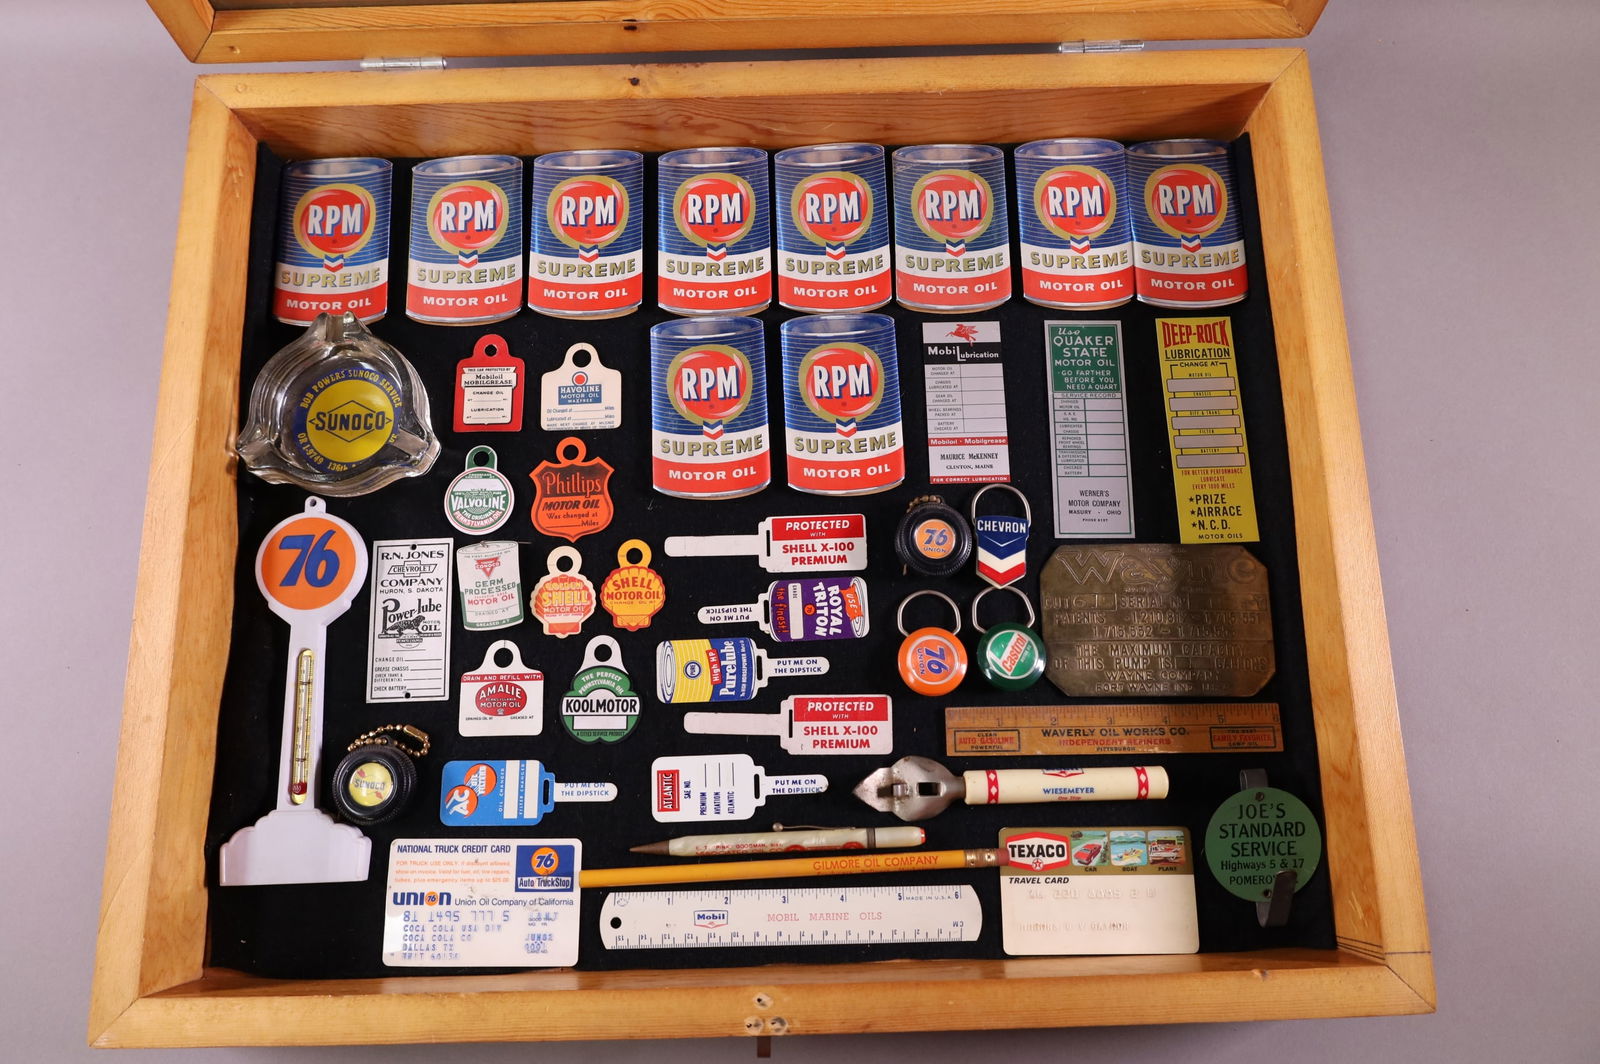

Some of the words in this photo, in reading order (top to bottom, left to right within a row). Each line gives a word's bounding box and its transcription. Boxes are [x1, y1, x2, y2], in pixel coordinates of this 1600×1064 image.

[925, 189, 980, 221] RPM
[1048, 185, 1104, 217] RPM
[1158, 184, 1214, 216] RPM
[561, 195, 615, 227] RPM
[687, 192, 742, 225] RPM
[805, 191, 860, 224] RPM
[307, 203, 363, 236] RPM
[440, 199, 496, 233] RPM
[785, 254, 884, 277] SUPREME
[905, 252, 1004, 273] SUPREME
[1031, 250, 1128, 270] SUPREME
[1142, 249, 1240, 269] SUPREME
[538, 259, 636, 278] SUPREME
[666, 256, 764, 277] SUPREME
[281, 268, 381, 288] SUPREME
[417, 263, 515, 285] SUPREME
[913, 282, 969, 295] MOTOR
[974, 281, 998, 292] OIL
[1040, 280, 1095, 292] MOTOR
[1100, 279, 1124, 289] OIL
[1151, 278, 1206, 290] MOTOR
[1211, 279, 1235, 288] OIL
[543, 288, 599, 300] MOTOR
[605, 288, 629, 299] OIL
[673, 287, 729, 300] MOTOR
[734, 286, 758, 297] OIL
[793, 286, 849, 299] MOTOR
[853, 285, 878, 296] OIL
[287, 298, 342, 311] MOTOR
[348, 297, 372, 310] OIL
[423, 295, 479, 307] MOTOR
[485, 293, 508, 305] OIL
[1053, 336, 1114, 346] QUAKER
[1161, 319, 1230, 349] DEEP-ROCK
[1063, 347, 1107, 357] STATE
[1164, 347, 1231, 359] LUBRICATION
[1054, 359, 1091, 367] MOTOR
[1097, 359, 1115, 367] OIL
[681, 366, 740, 400] RPM
[813, 363, 871, 398] RPM
[300, 391, 314, 409] BOB
[312, 370, 346, 393] POWERS
[348, 369, 379, 382] SUNOCO
[379, 379, 403, 408] SERVICE
[560, 385, 600, 393] HAVOLINE
[315, 411, 386, 431] SUNOCO
[660, 434, 763, 457] SUPREME
[794, 432, 897, 455] SUPREME
[669, 470, 727, 481] MOTOR
[732, 466, 757, 477] OIL
[803, 467, 861, 478] MOTOR
[866, 464, 891, 476] OIL
[542, 472, 601, 497] Phillips
[451, 494, 506, 511] VALVOLINE
[542, 501, 580, 512] MOTOR
[583, 499, 600, 509] OIL
[1195, 493, 1227, 505] PRIZE
[562, 512, 589, 520] changed
[1196, 505, 1242, 518] AIRRACE
[785, 520, 850, 531] PROTECTED
[977, 520, 1027, 534] CHEVRON
[924, 528, 948, 546] 76
[782, 543, 817, 554] SHELL
[820, 541, 854, 552] X-100
[278, 529, 340, 588] 76
[791, 555, 848, 566] PREMIUM
[393, 565, 432, 573] CHEVROLET
[380, 578, 444, 588] COMPANY
[465, 582, 516, 595] PROCESSED
[475, 578, 504, 588] GERM
[612, 576, 652, 591] SHELL
[501, 594, 514, 602] OIL
[541, 590, 589, 606] SHELL
[606, 591, 643, 600] MOTOR
[645, 591, 661, 600] OIL
[812, 581, 827, 637] TRITON
[827, 584, 843, 636] ROYAL
[1001, 633, 1028, 673] Castrol
[1075, 644, 1099, 656] THE
[1109, 644, 1172, 656] MAXIMUM
[720, 640, 735, 696] Purelube
[924, 647, 949, 675] 76
[480, 684, 522, 700] AMALIE
[565, 699, 637, 713] KOOLMOTOR
[807, 701, 874, 712] PROTECTED
[803, 726, 839, 736] SHELL
[843, 726, 878, 735] X-100
[1041, 729, 1094, 738] WAVERLY
[1100, 728, 1120, 737] OIL
[1123, 727, 1166, 736] WORKS
[1170, 727, 1190, 735] CO.
[812, 739, 871, 749] PREMIUM
[1059, 738, 1122, 746] INDEPENDENT
[354, 779, 386, 790] SUNOCO
[663, 773, 674, 809] ATLANTIC
[1043, 787, 1094, 795] WIESEMEYER
[446, 789, 470, 816] AC
[1238, 803, 1286, 820] JOE'S
[1219, 822, 1305, 839] STANDARD
[397, 845, 432, 853] NATIONAL
[434, 845, 459, 853] TRUCK
[461, 845, 488, 853] CREDIT
[491, 845, 511, 853] CARD
[1009, 844, 1066, 858] TEXACO
[1231, 841, 1297, 858] SERVICE
[535, 853, 555, 868] 76
[813, 859, 861, 870] GILMORE
[864, 857, 882, 868] OIL
[886, 855, 939, 867] COMPANY
[1221, 859, 1266, 872] Highways
[1270, 860, 1276, 869] 5
[1280, 859, 1288, 868] &
[1293, 858, 1305, 868] 17
[519, 877, 535, 888] Auto
[537, 876, 571, 889] TruckStop
[454, 898, 477, 906] Union
[479, 898, 490, 906] Oil
[491, 898, 527, 907] Company
[529, 897, 537, 906] of
[539, 897, 574, 906] California
[403, 911, 417, 922] 81
[428, 911, 461, 922] 1495
[471, 910, 494, 922] 777
[503, 911, 510, 922] 5
[697, 912, 726, 921] Mobil
[767, 913, 799, 922] MOBIL
[809, 912, 850, 921] MARINE
[859, 911, 882, 920] OILS
